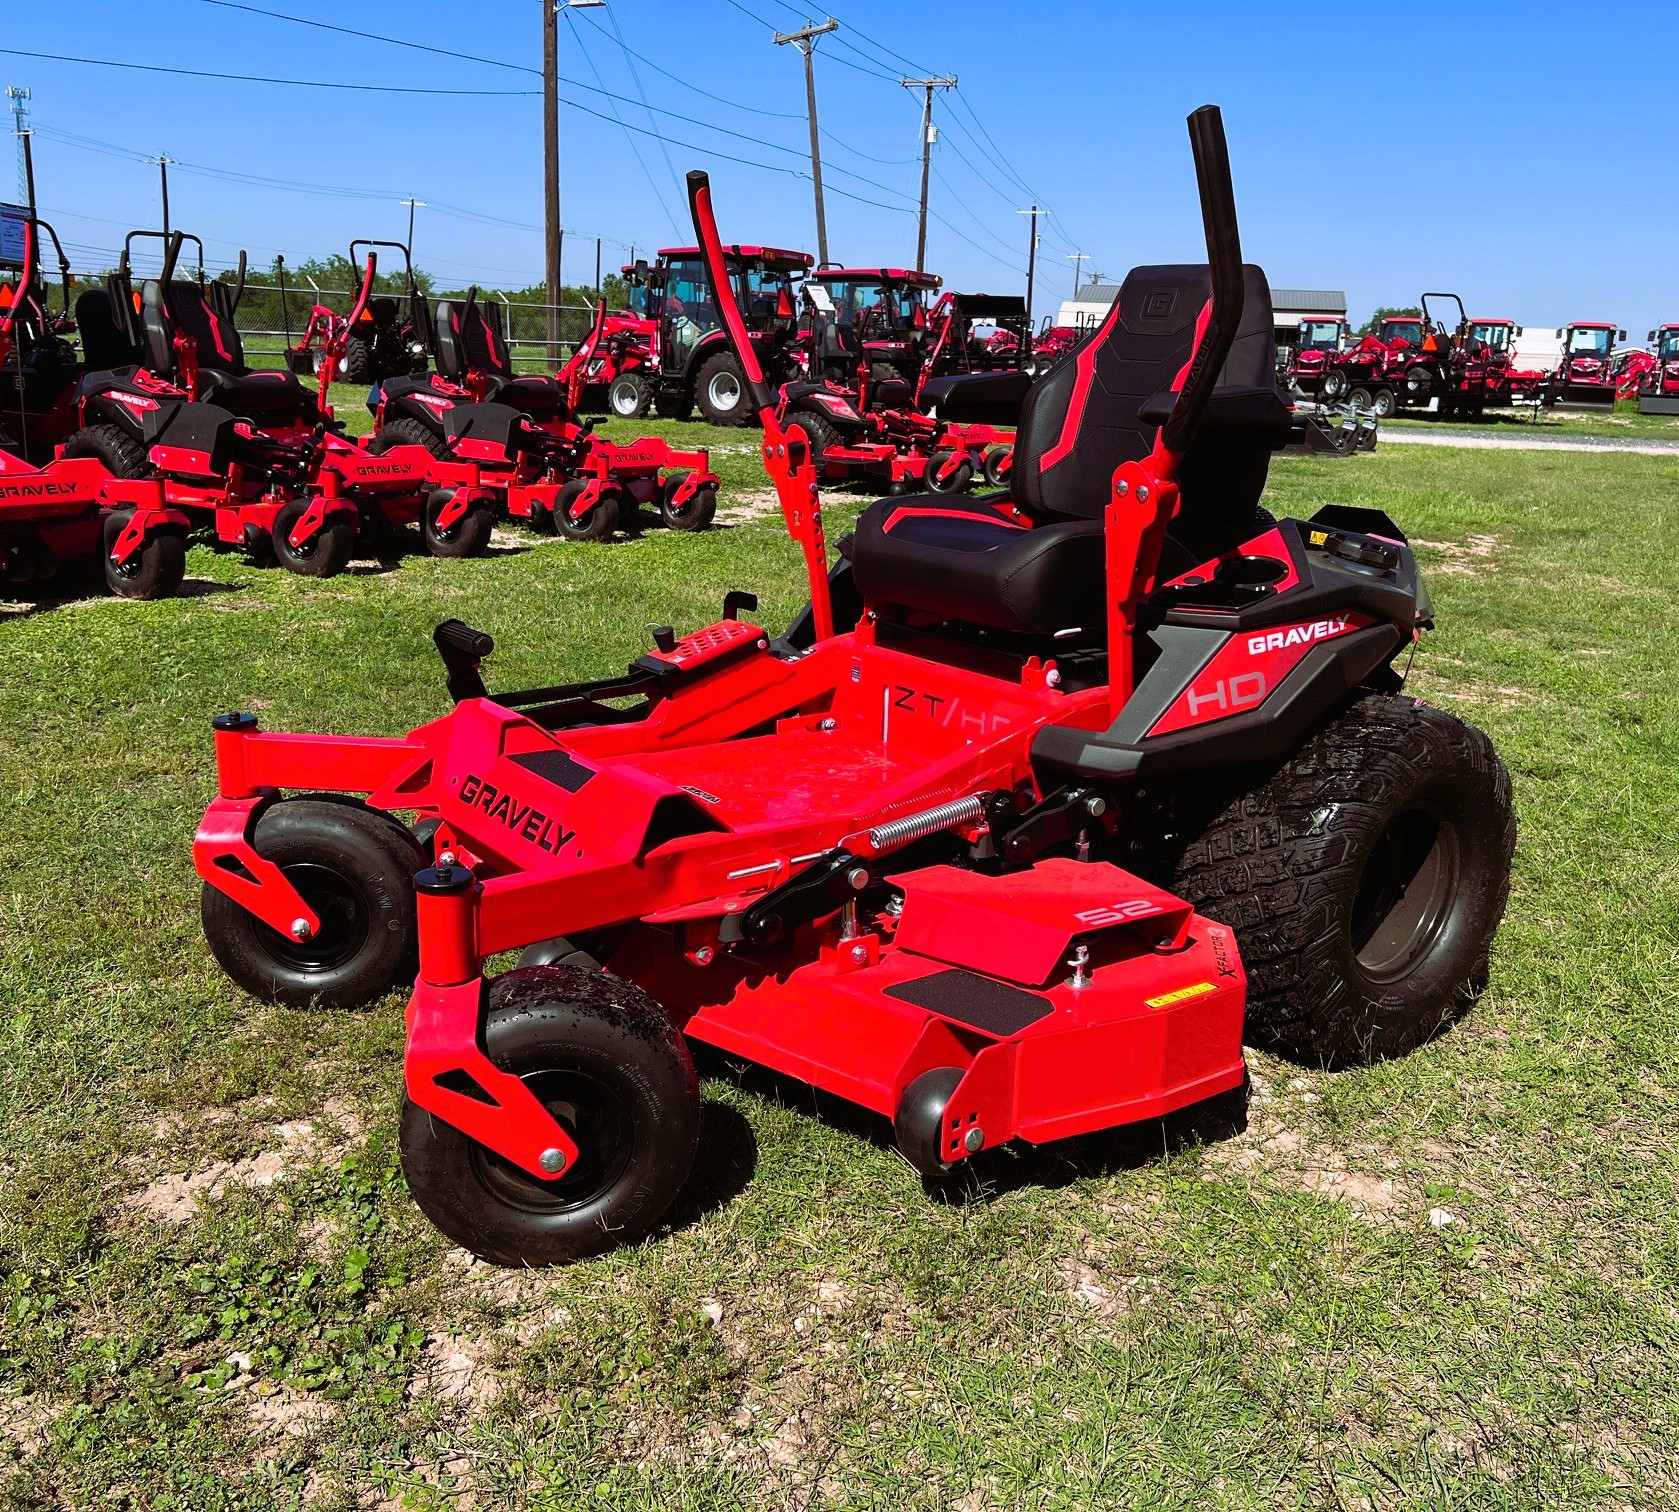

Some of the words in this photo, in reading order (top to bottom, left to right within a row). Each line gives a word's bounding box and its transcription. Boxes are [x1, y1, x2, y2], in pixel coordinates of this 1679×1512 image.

[110, 390, 150, 408] GRAVELY
[357, 463, 413, 476] GRAVELY
[1247, 613, 1350, 656] GRAVELY
[1187, 671, 1266, 717] HD
[459, 773, 577, 857] GRAVELY
[1073, 900, 1164, 925] 52
